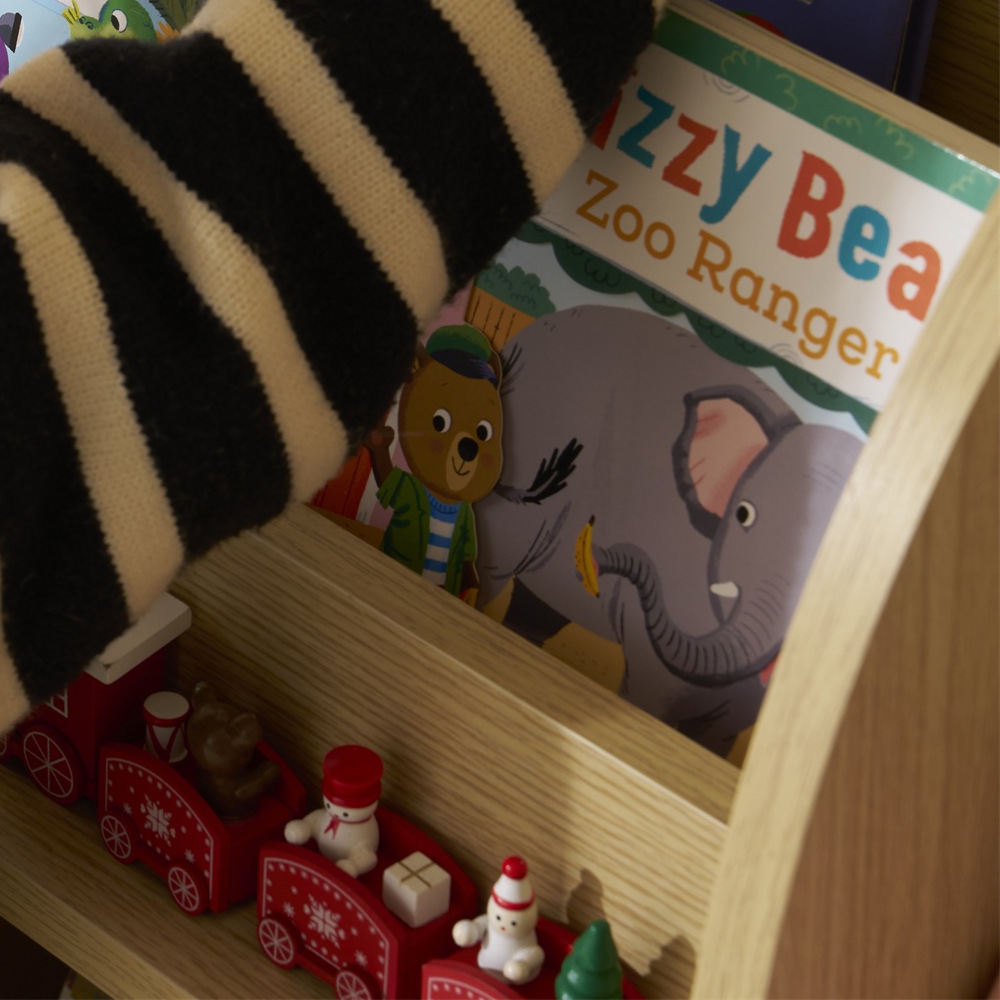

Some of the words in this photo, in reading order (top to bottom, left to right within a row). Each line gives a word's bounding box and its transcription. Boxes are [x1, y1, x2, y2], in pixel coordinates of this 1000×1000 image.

[575, 168, 676, 260] Zoo
[686, 229, 900, 380] Ranger
[592, 69, 773, 225] izzy
[776, 149, 942, 322] Bea
